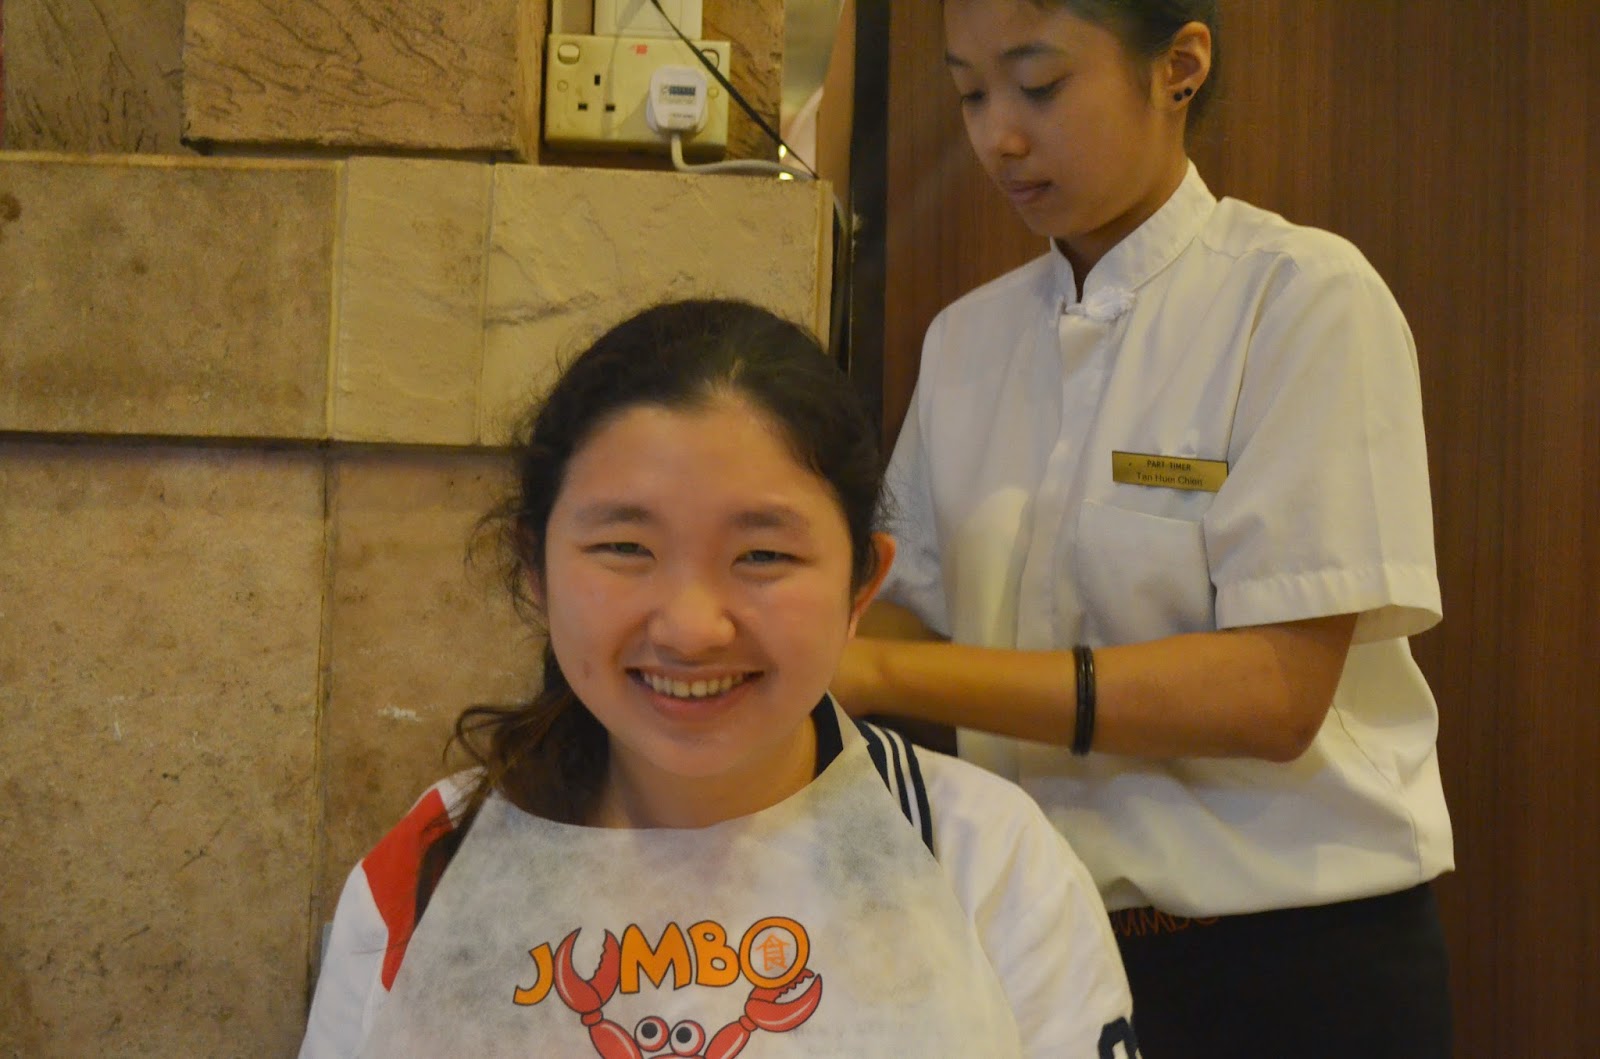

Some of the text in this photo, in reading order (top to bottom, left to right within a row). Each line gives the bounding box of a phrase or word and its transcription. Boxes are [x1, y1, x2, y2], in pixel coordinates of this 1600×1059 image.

[1146, 459, 1192, 471] PART TIMER
[1136, 472, 1153, 482] Tan
[512, 916, 810, 1011] JUMBO
